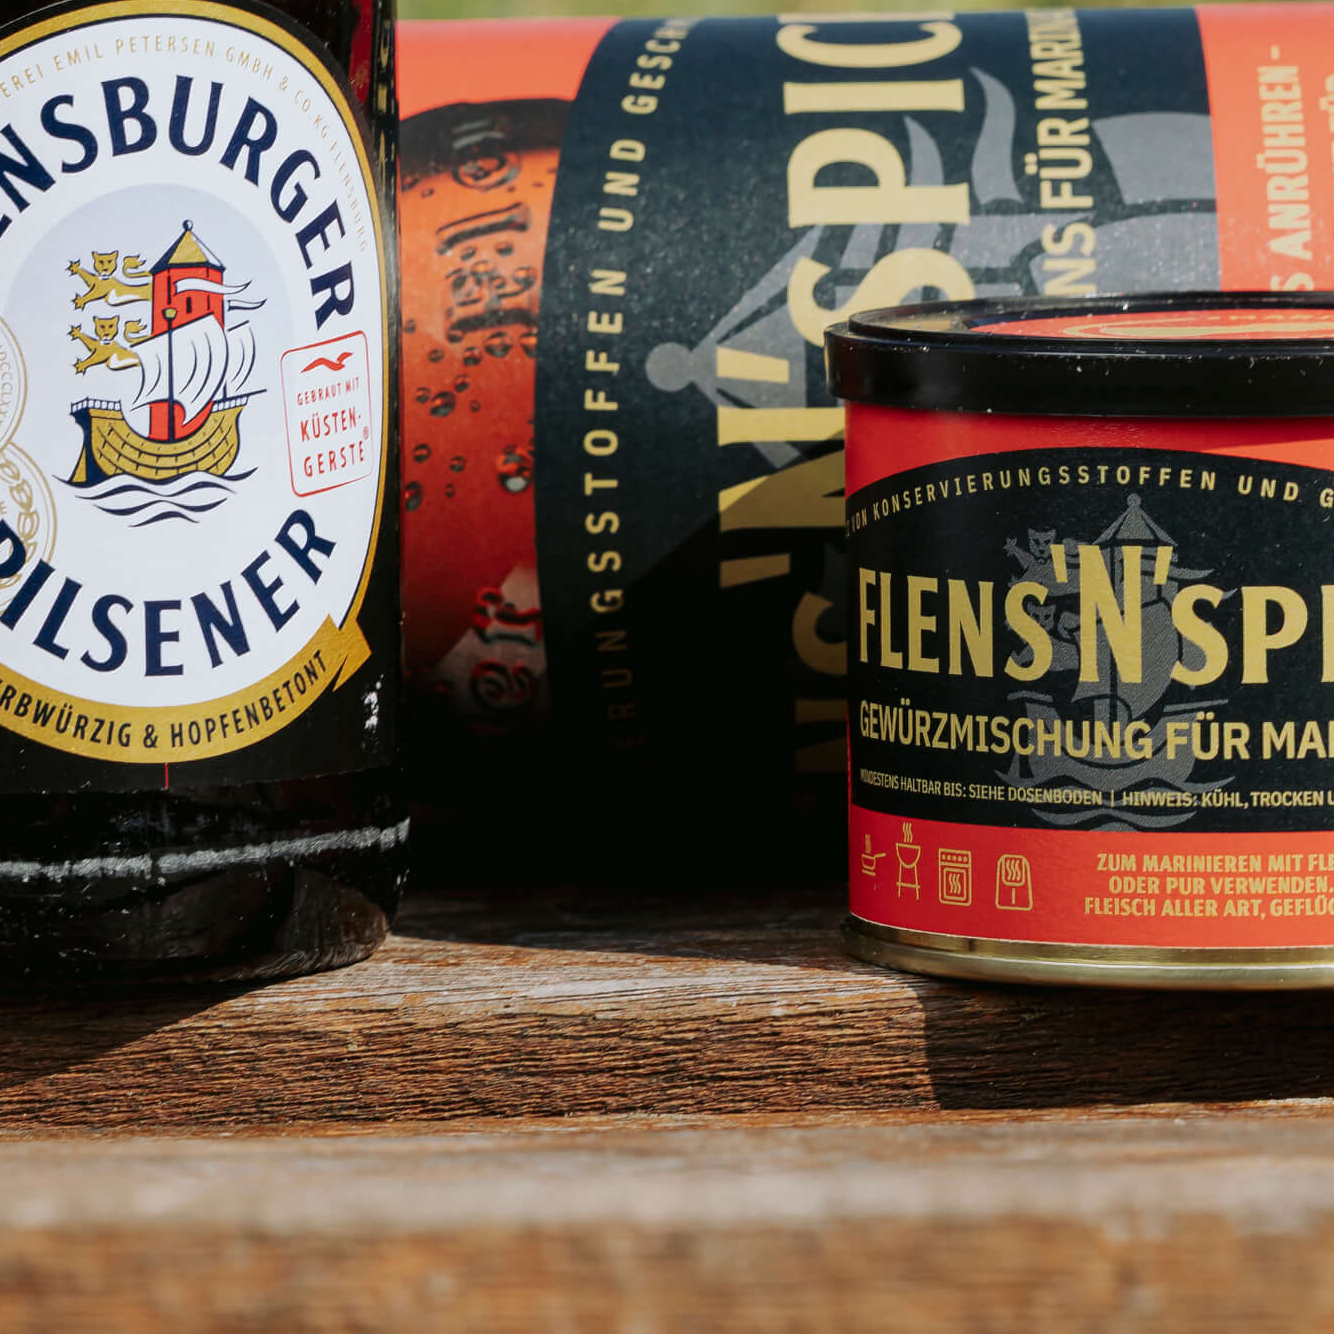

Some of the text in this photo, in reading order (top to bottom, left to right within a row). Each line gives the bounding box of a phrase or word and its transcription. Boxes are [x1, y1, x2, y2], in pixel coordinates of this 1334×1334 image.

[53, 43, 104, 72] EMIL
[114, 34, 216, 58] PETERSEN
[225, 46, 273, 82] GMBH
[278, 75, 289, 91] &
[596, 138, 646, 233] UND
[1024, 117, 1095, 210] FÜR
[1256, 65, 1313, 261] ANRÜHREN
[296, 377, 360, 406] GEBRAUT MIT
[872, 464, 1218, 522] KONSERVIERUNGSSTOFFEN
[1237, 475, 1300, 503] UND
[142, 723, 159, 749] &
[170, 649, 328, 748] HOPFENBETONT
[859, 698, 1154, 760] GEWÜRZMISCHUNG
[1165, 711, 1251, 761] FÜR
[900, 776, 942, 796] HALTBAR
[943, 781, 967, 798] BIS:
[968, 783, 1006, 802] SIEHE
[1007, 786, 1103, 806] DOSENBODEN
[1122, 791, 1199, 808] HINWEIS:
[1201, 788, 1249, 809] KÜHL,
[1250, 791, 1324, 808] TROCKEN
[1096, 853, 1137, 872] ZUM
[1142, 854, 1262, 873] MARINIEREN
[1267, 853, 1304, 872] MIT
[1108, 875, 1160, 894] ODER
[1166, 876, 1206, 895] PUR
[1210, 875, 1334, 895] VERWENDEN.
[1084, 897, 1156, 916] FLEISCH
[1161, 898, 1218, 917] ALLER
[1223, 898, 1266, 921] ART,
